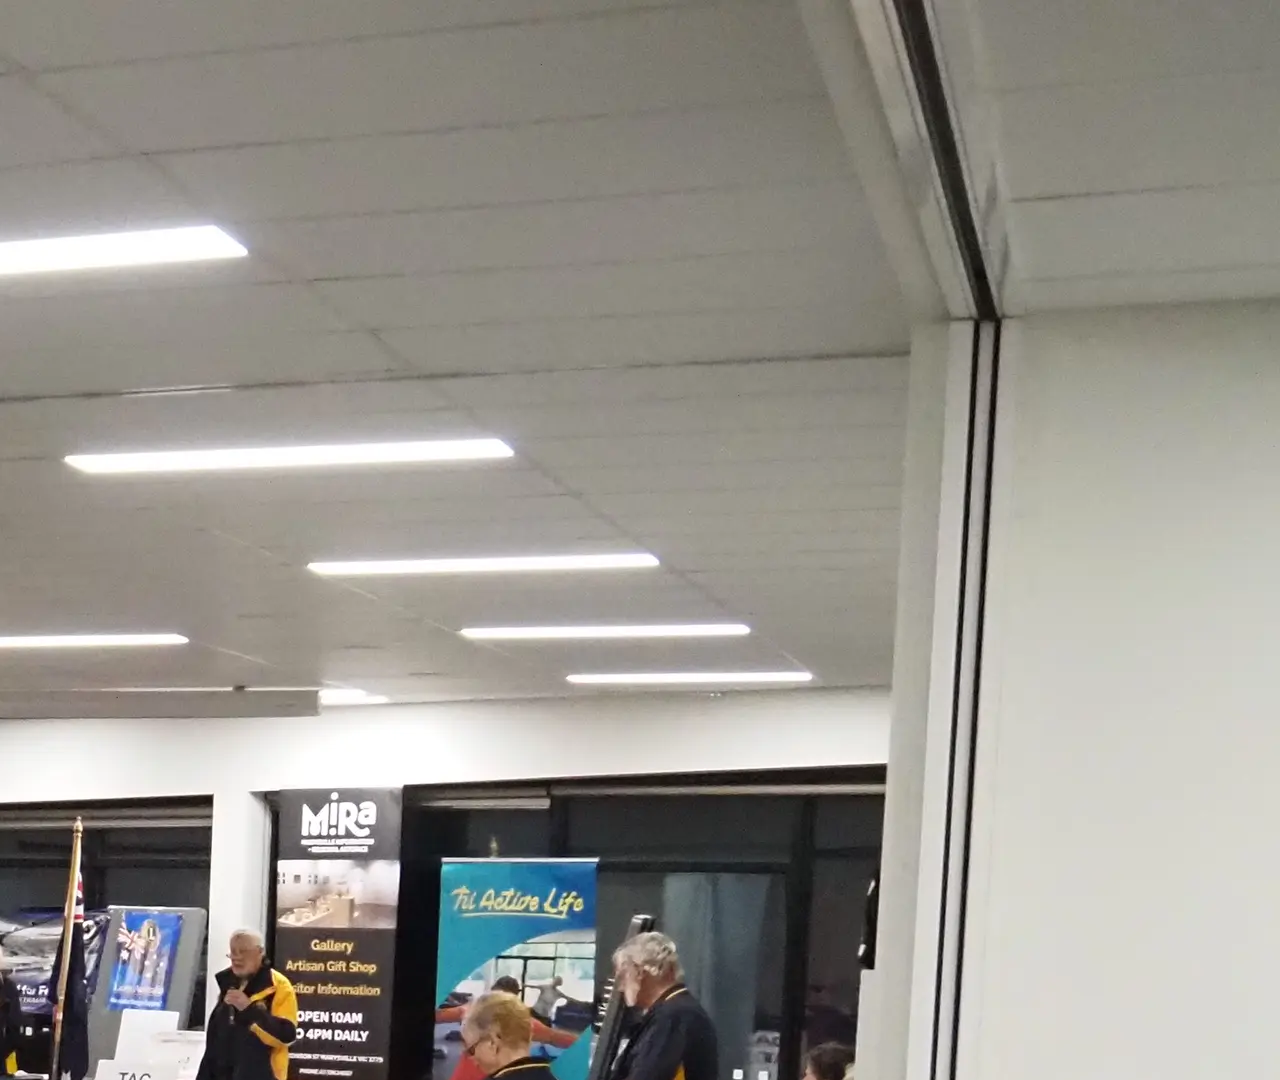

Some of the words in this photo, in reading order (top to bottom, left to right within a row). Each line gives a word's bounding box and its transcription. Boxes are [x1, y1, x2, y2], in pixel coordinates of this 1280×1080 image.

[310, 939, 355, 956] Gallery
[285, 960, 325, 973] Artisan
[326, 961, 347, 973] Gift
[348, 961, 378, 976] Shop
[292, 982, 317, 995] sitor
[317, 983, 382, 997] Information
[297, 1010, 330, 1023] OPEN
[330, 1011, 364, 1025] 10AM
[305, 1028, 333, 1041] 4PM
[333, 1030, 370, 1042] DAILY
